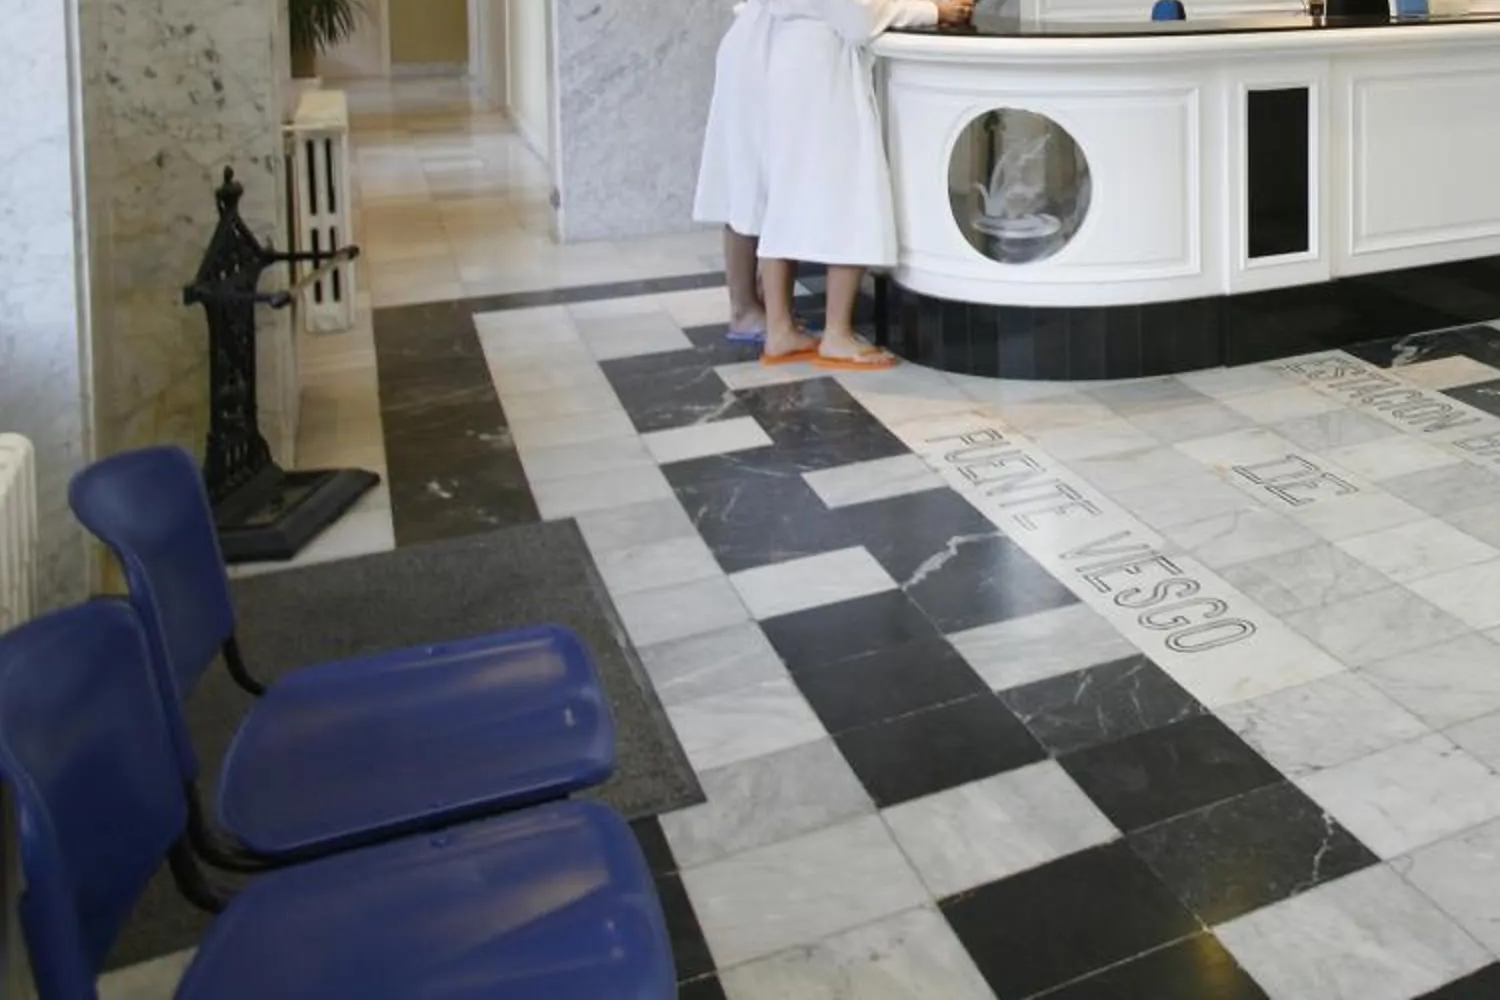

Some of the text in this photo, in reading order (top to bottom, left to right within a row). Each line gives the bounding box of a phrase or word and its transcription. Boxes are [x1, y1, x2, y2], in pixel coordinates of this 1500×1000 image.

[924, 429, 1257, 653] PUENTE VIESGO
[1231, 454, 1360, 506] DE
